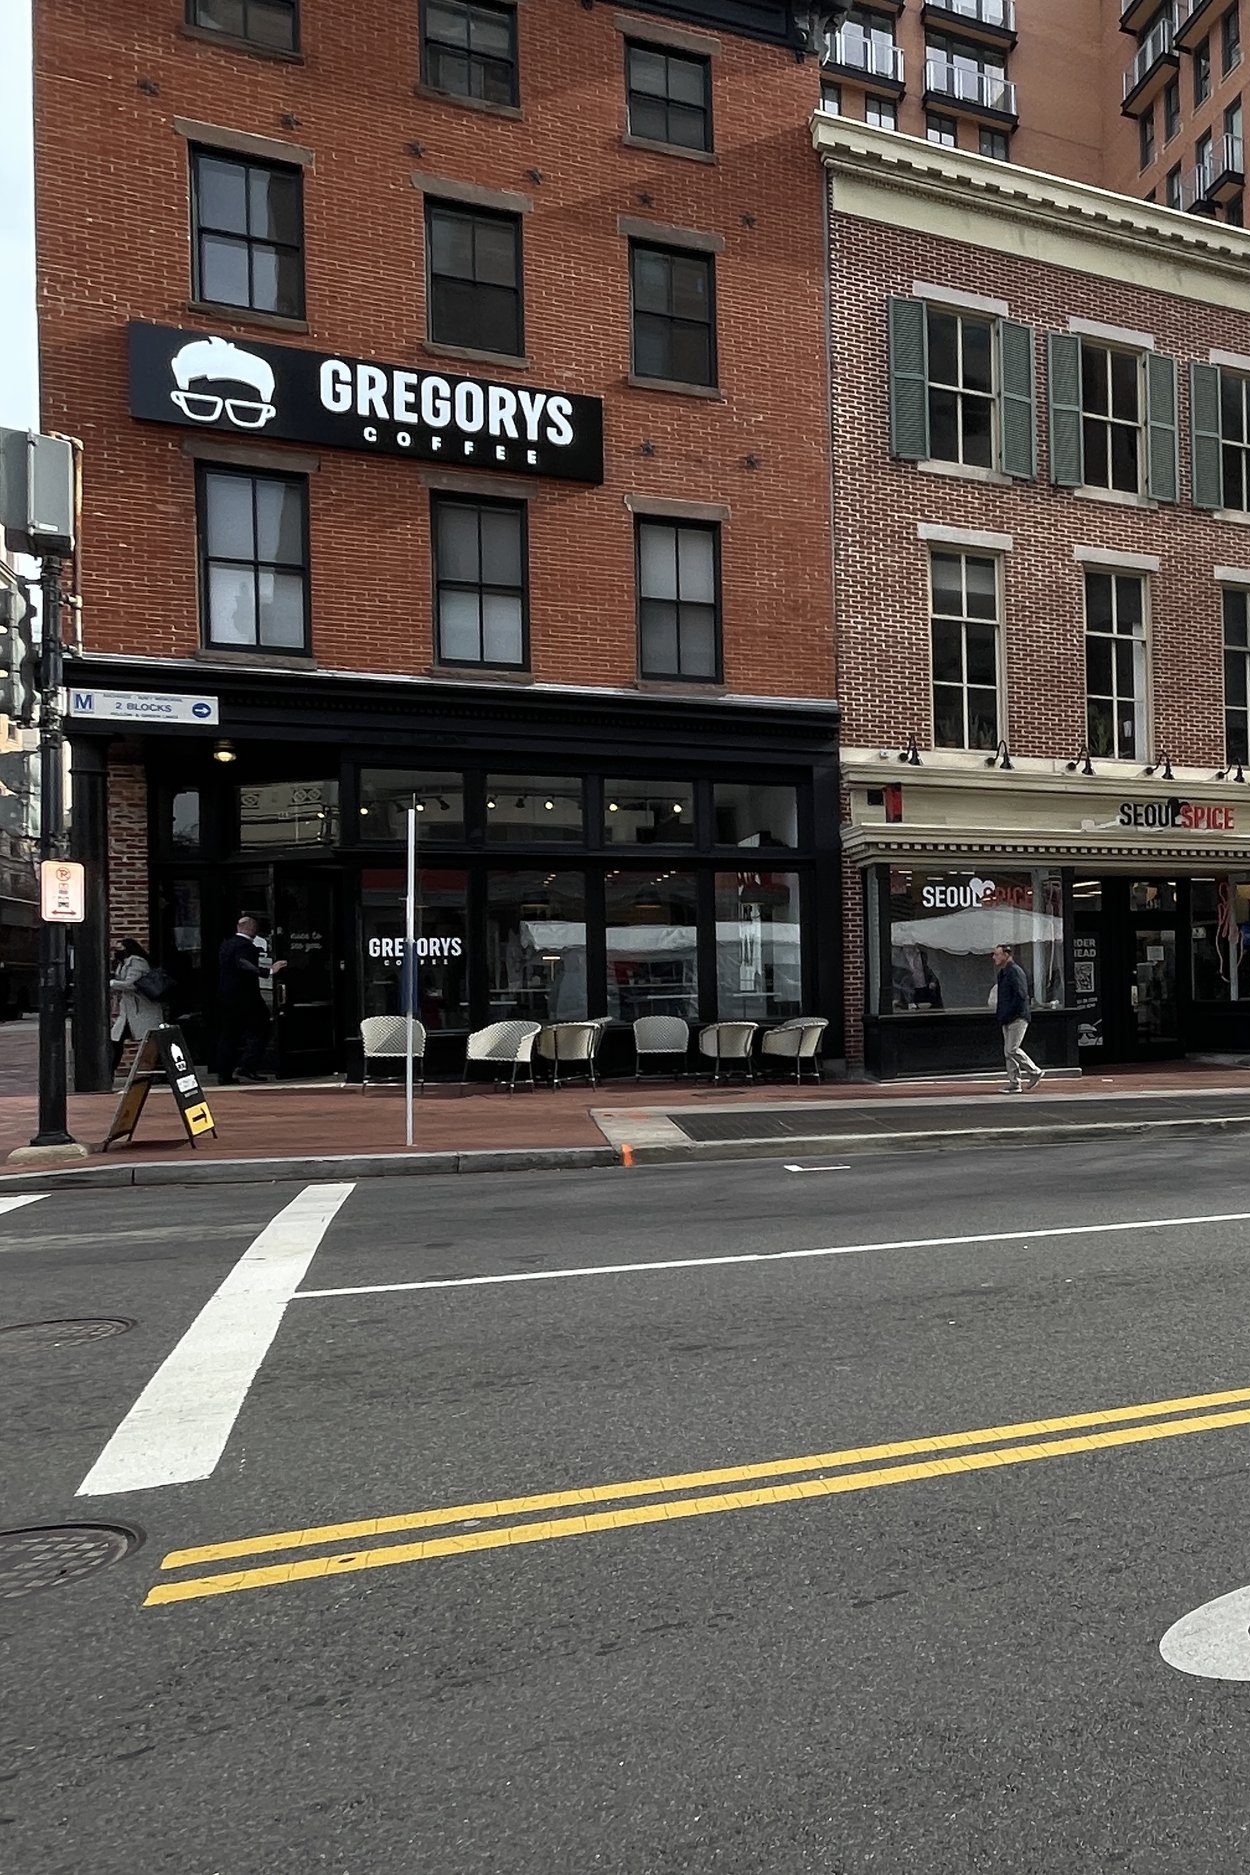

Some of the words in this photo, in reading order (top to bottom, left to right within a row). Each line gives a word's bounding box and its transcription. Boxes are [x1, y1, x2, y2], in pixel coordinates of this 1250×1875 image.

[319, 359, 574, 447] GREGORYS
[363, 426, 538, 466] COFFEE
[75, 694, 93, 710] M
[115, 702, 122, 710] 2
[126, 702, 172, 713] BLOCKS
[368, 937, 462, 957] GREORYS
[383, 958, 449, 966] COFEE
